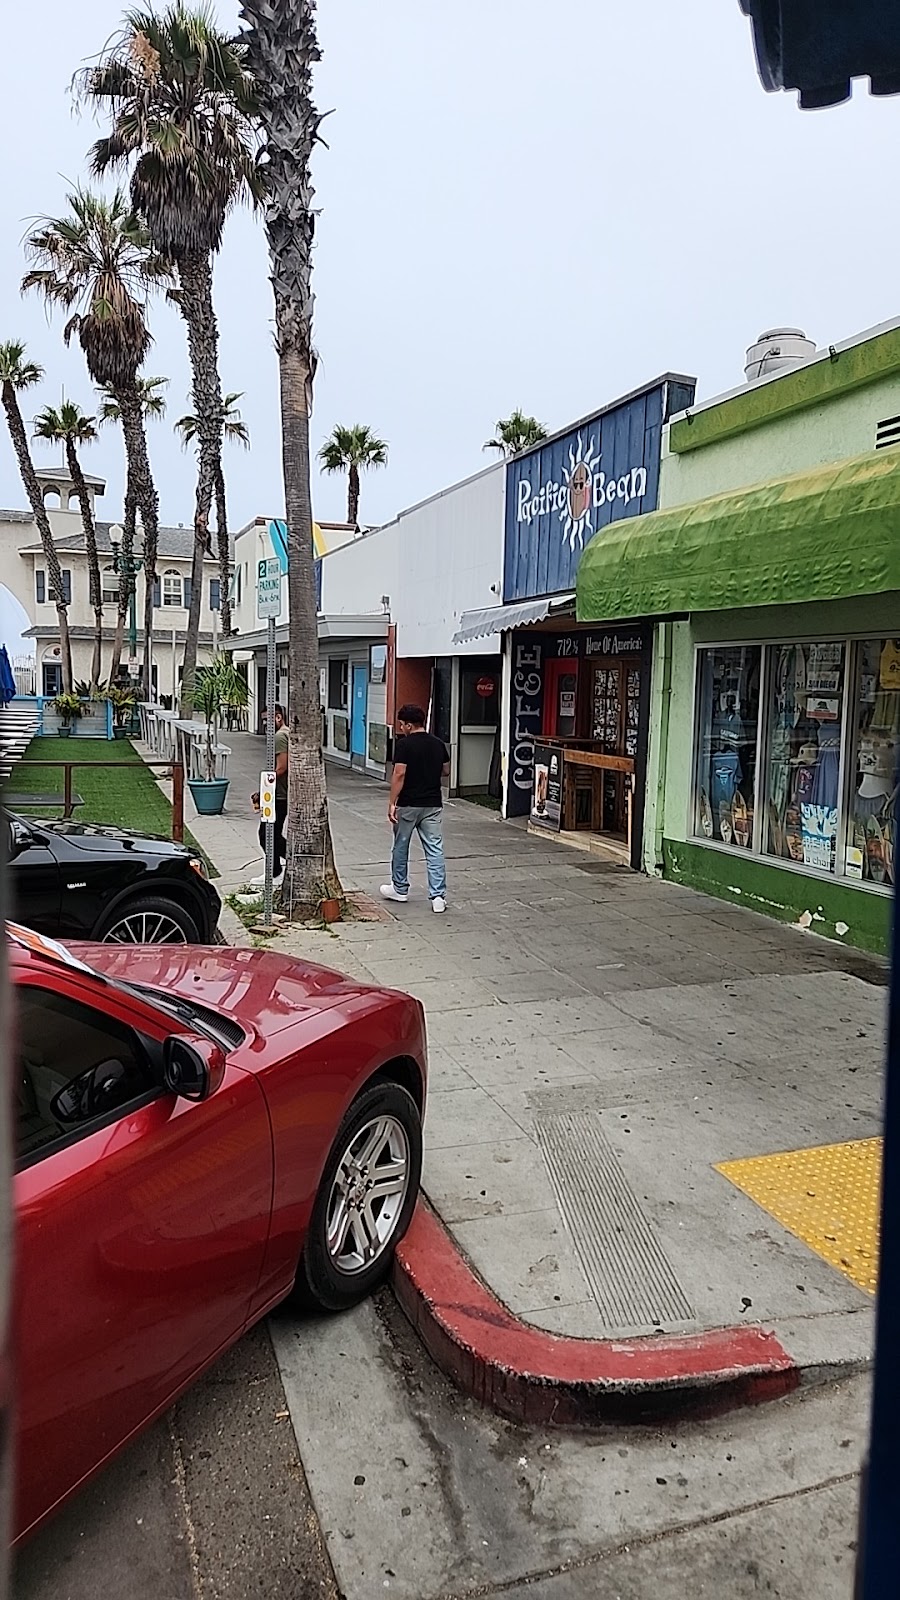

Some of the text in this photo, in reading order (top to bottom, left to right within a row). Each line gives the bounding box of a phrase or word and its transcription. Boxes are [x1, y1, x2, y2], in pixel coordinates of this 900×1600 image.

[517, 467, 647, 525] Pacific Bean
[260, 562, 279, 576] 2 HOUR
[259, 578, 279, 592] PARKING
[557, 637, 572, 656] 712
[586, 637, 602, 655] Home
[512, 645, 542, 790] COFFEE
